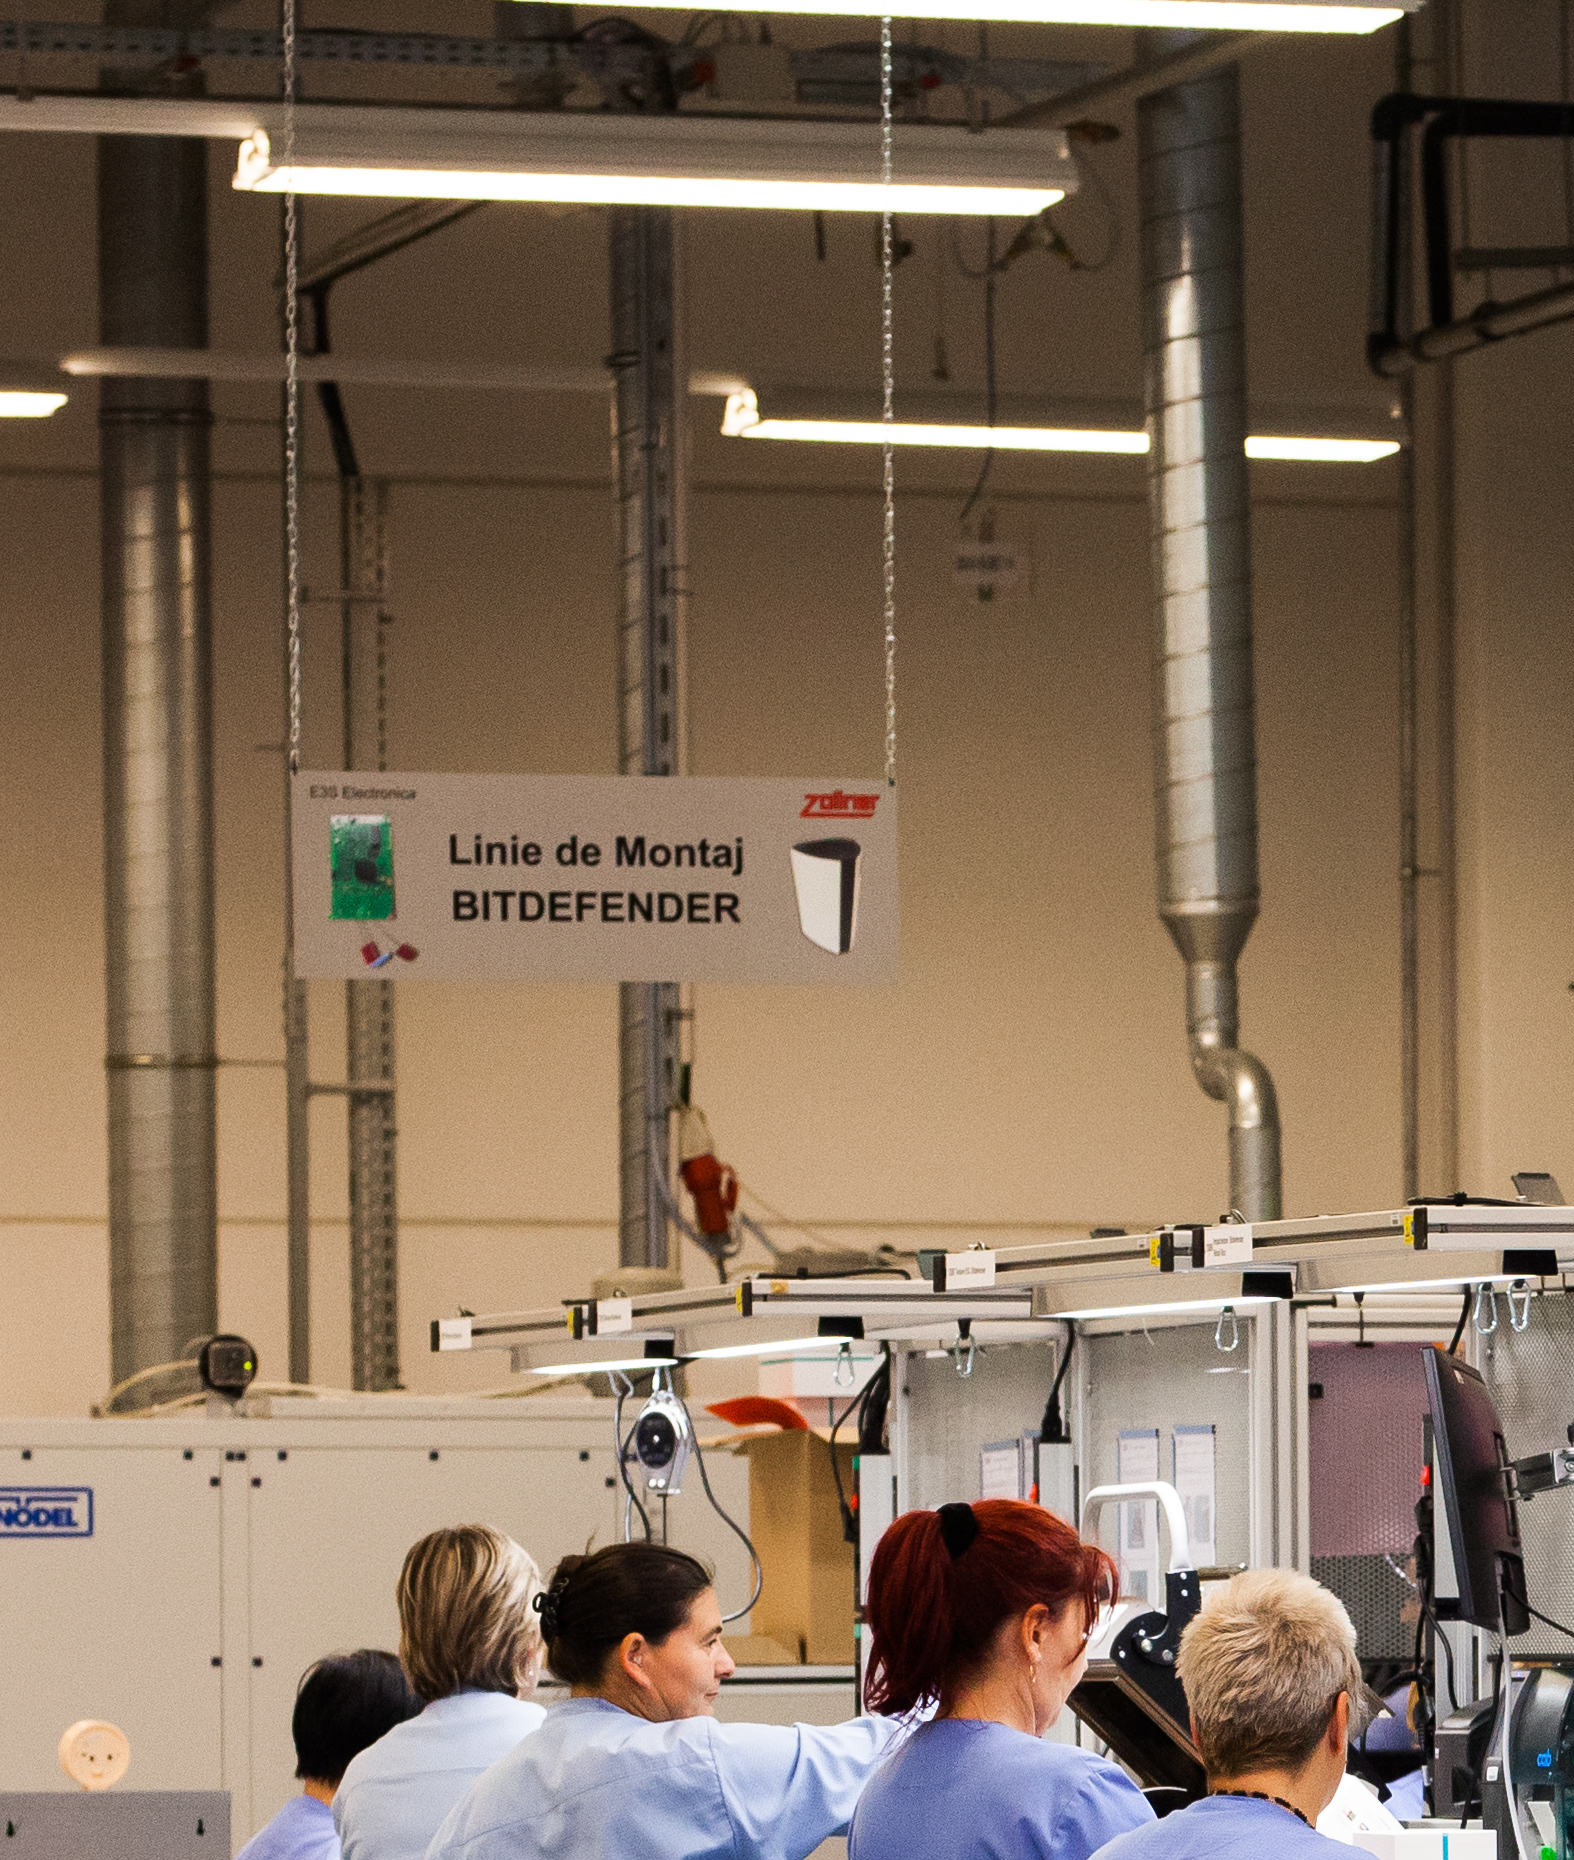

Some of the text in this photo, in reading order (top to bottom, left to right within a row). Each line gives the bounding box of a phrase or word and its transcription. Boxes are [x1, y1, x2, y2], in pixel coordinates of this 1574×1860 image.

[449, 834, 743, 876] Linie de Montaj
[453, 890, 740, 923] BITDEFENDER
